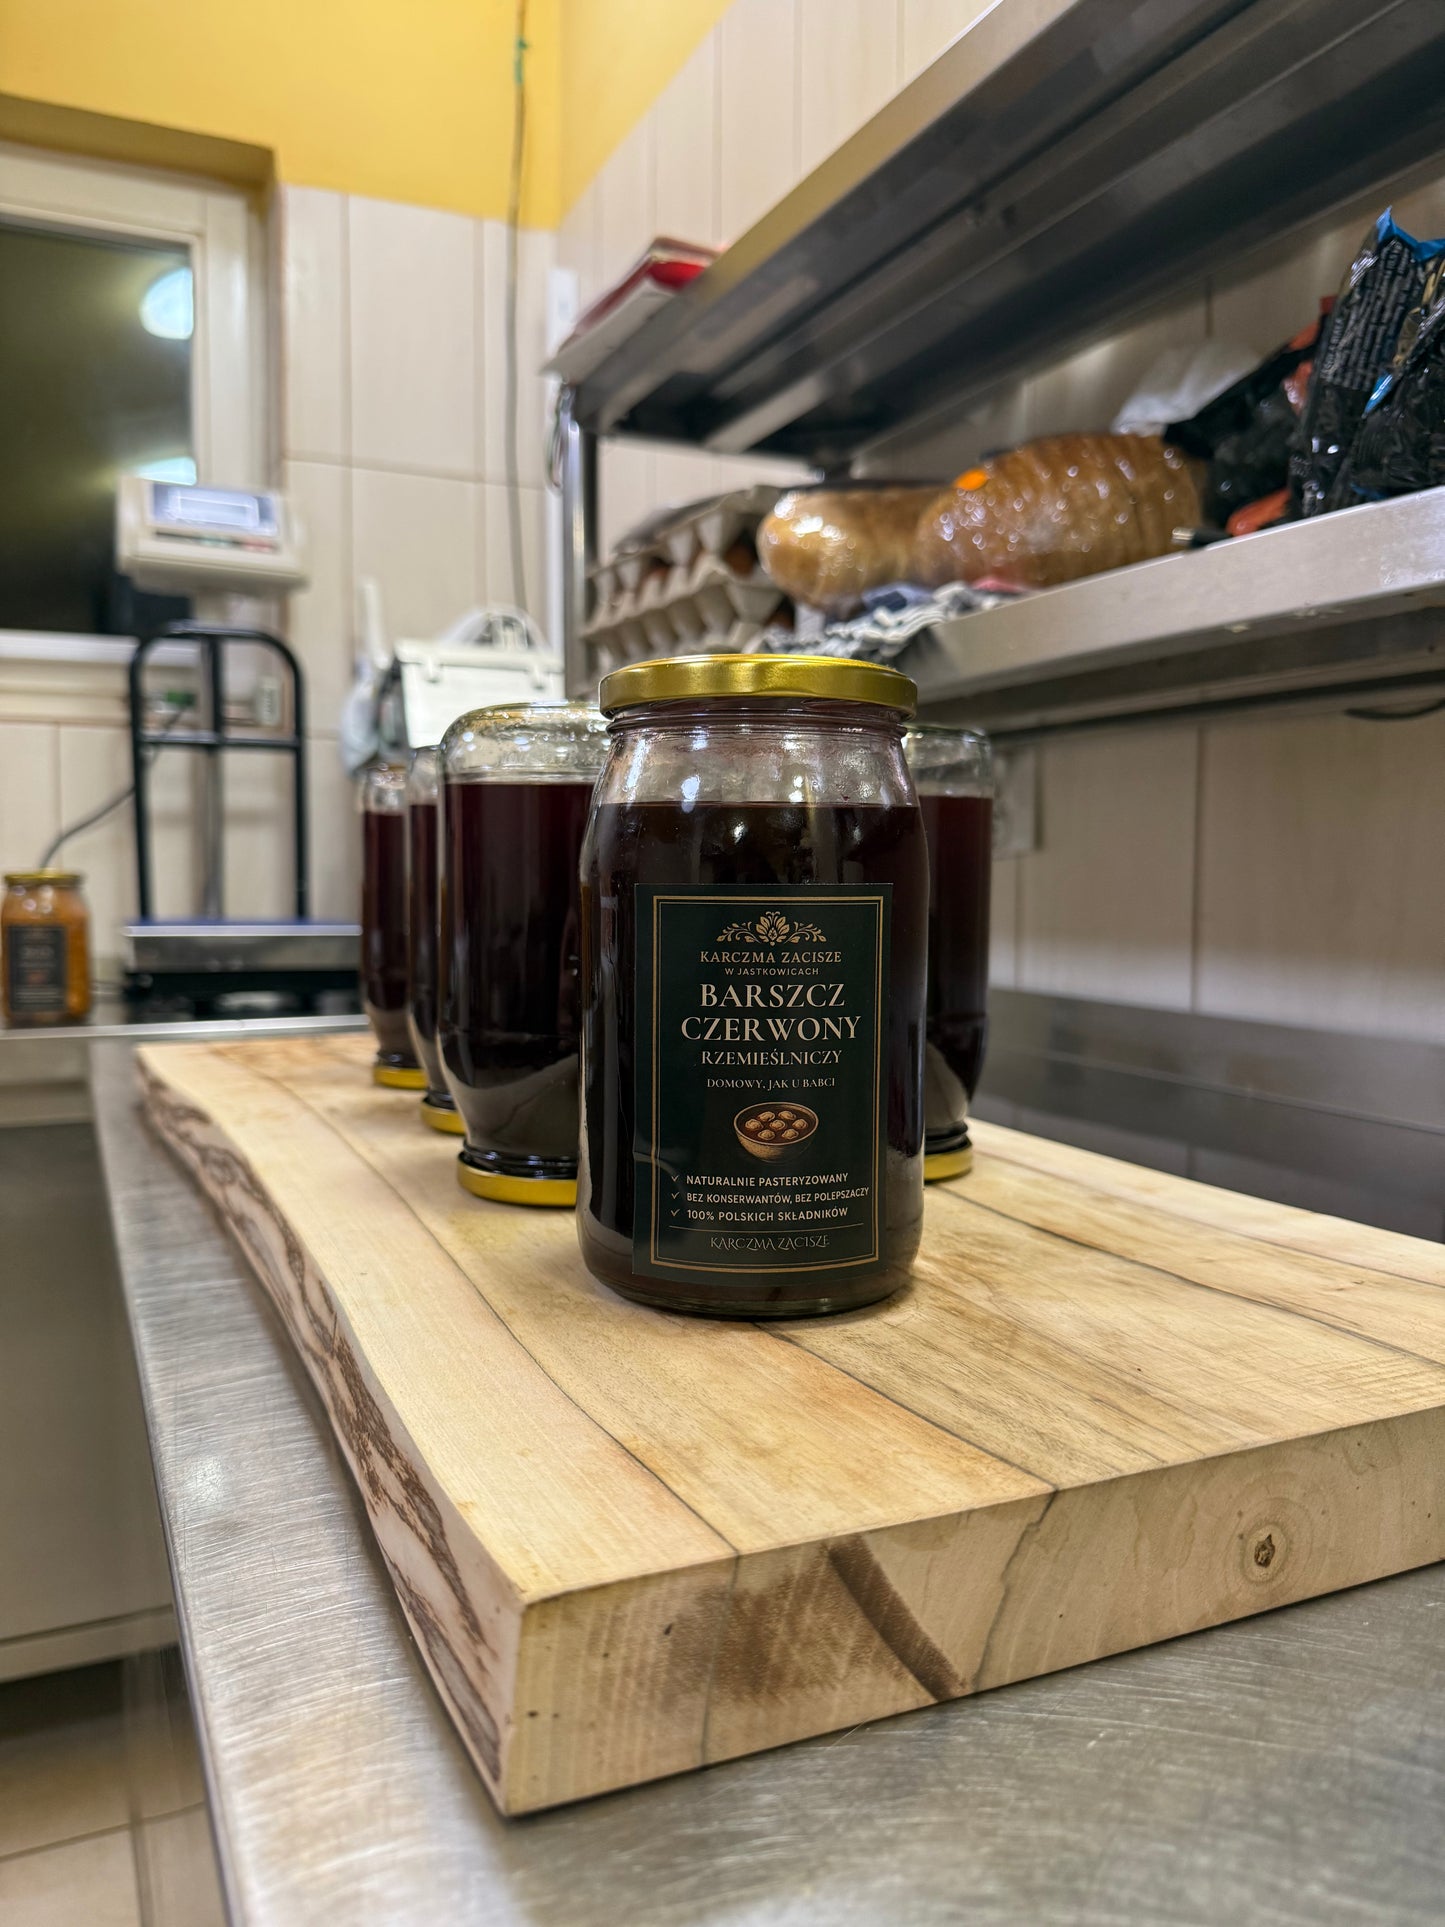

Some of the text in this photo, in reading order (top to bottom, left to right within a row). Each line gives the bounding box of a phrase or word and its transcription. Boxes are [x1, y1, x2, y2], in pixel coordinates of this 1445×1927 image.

[700, 951, 842, 963] KARCZMA ZACISZE
[724, 967, 819, 976] W JASTKOWICACH
[700, 983, 845, 1008] BARSZCZ
[681, 1016, 861, 1041] CZERWONY
[701, 1048, 842, 1066] RZEMIEŚLNICZY
[768, 1079, 789, 1091] JAK
[792, 1079, 800, 1088] U
[803, 1078, 835, 1088] BABCI
[686, 1172, 849, 1187] NATURALNIE PASTERYZOWANY
[686, 1187, 870, 1205] BEZ KONSERWANTÓW, BEZ POLEPSZACZY
[687, 1206, 848, 1222] 100% POLSKICH SKŁADNIKÓW
[710, 1235, 830, 1251] KARCZMA ZACISZE
